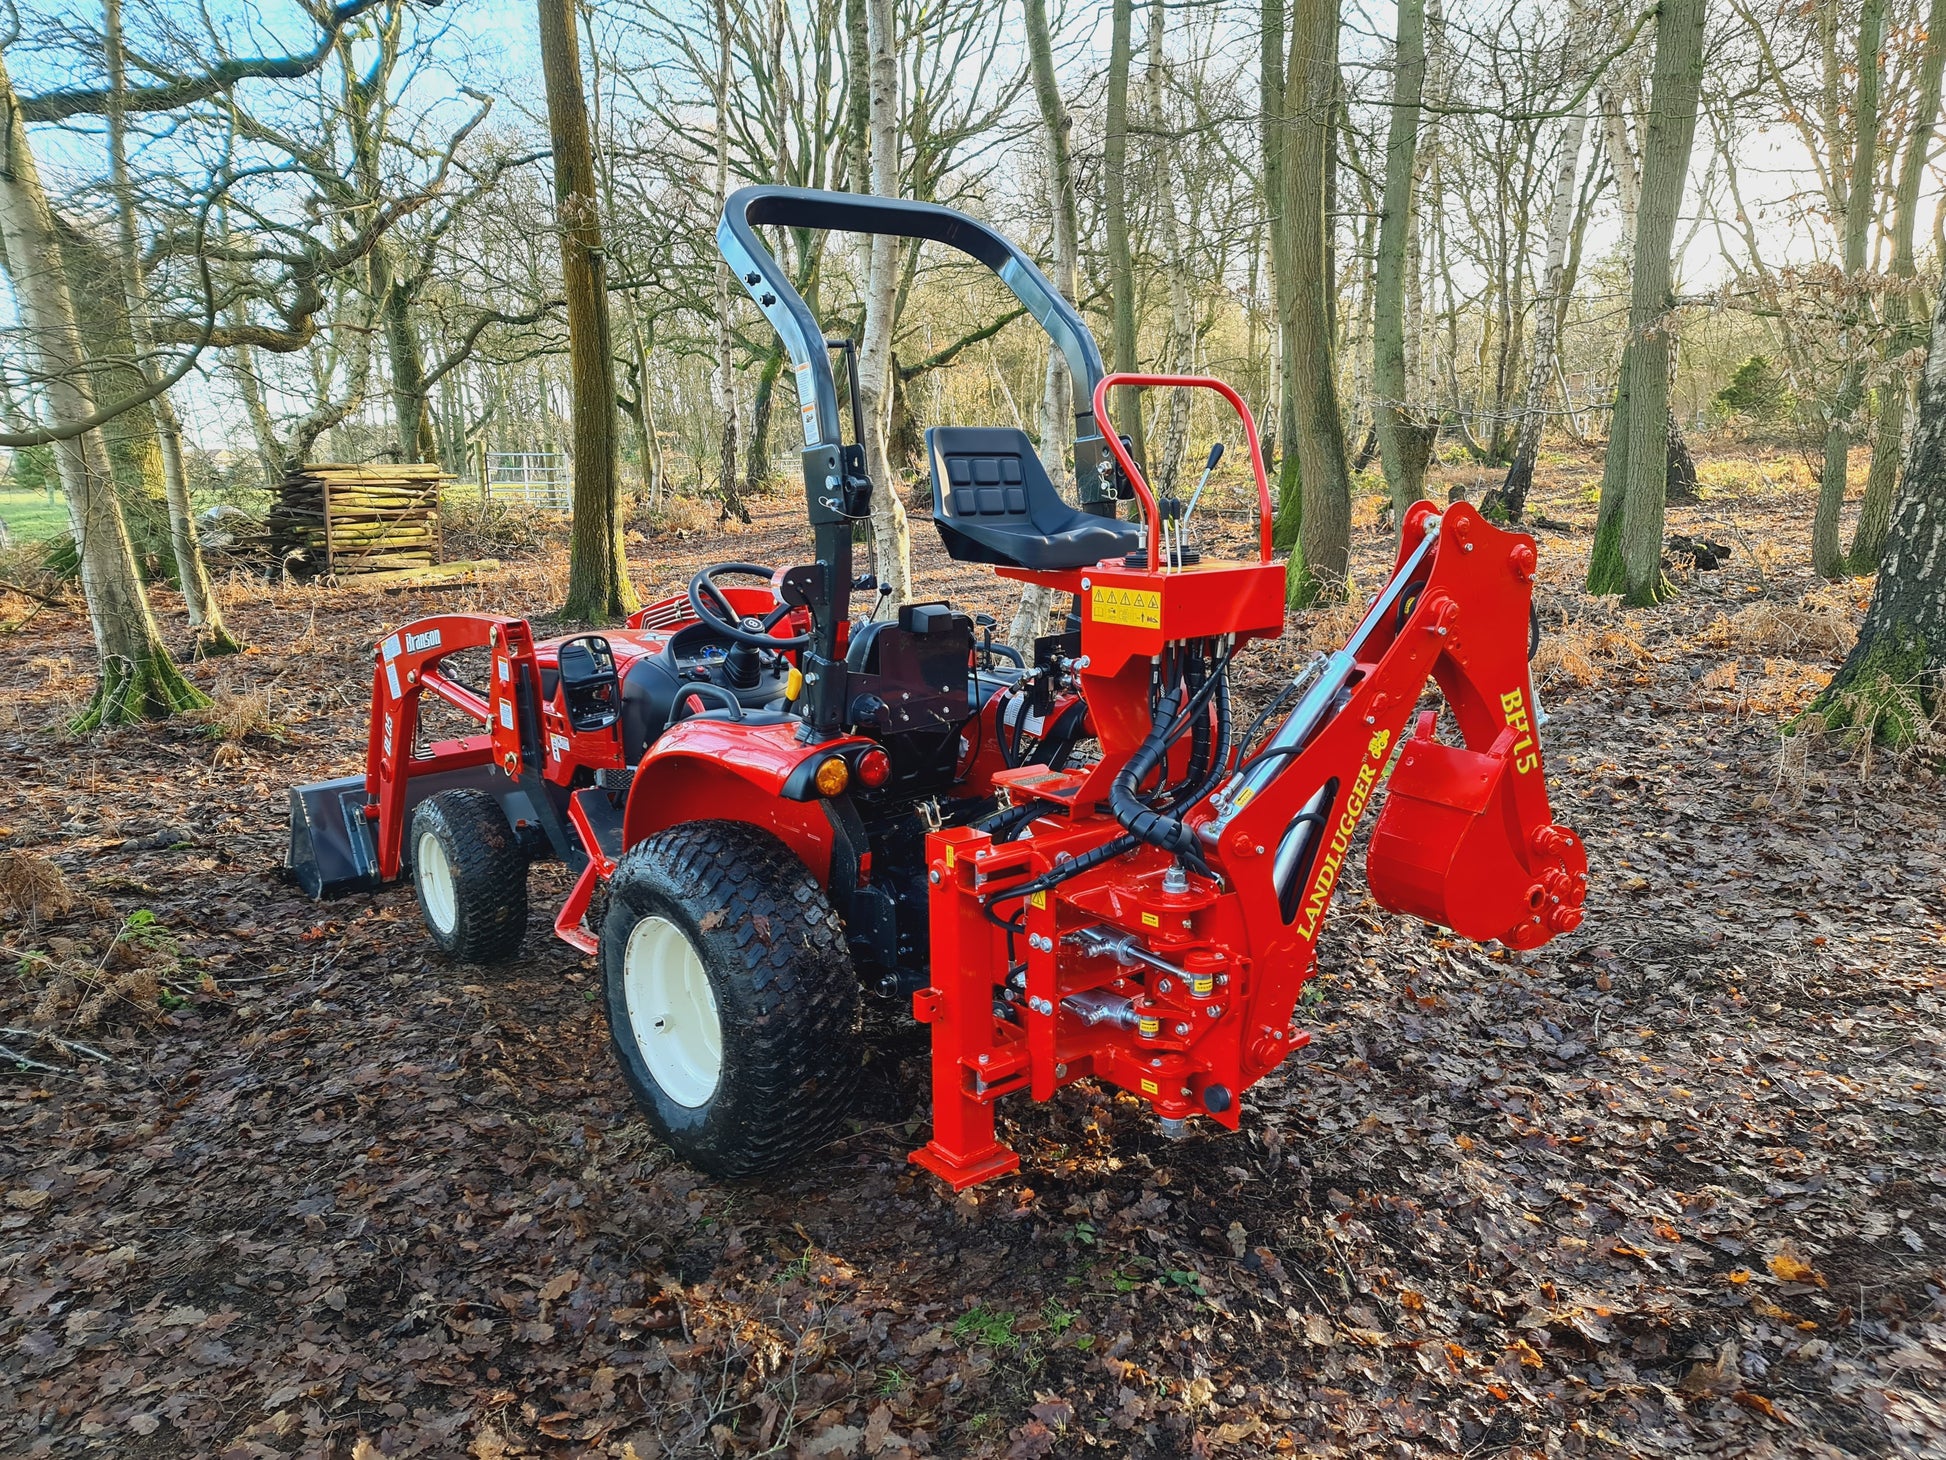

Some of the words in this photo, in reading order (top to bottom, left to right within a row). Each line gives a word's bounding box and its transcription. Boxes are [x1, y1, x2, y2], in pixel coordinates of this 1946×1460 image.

[405, 629, 441, 653] Branson
[1500, 687, 1538, 774] BH15
[1297, 763, 1376, 941] LANDLUGGER
